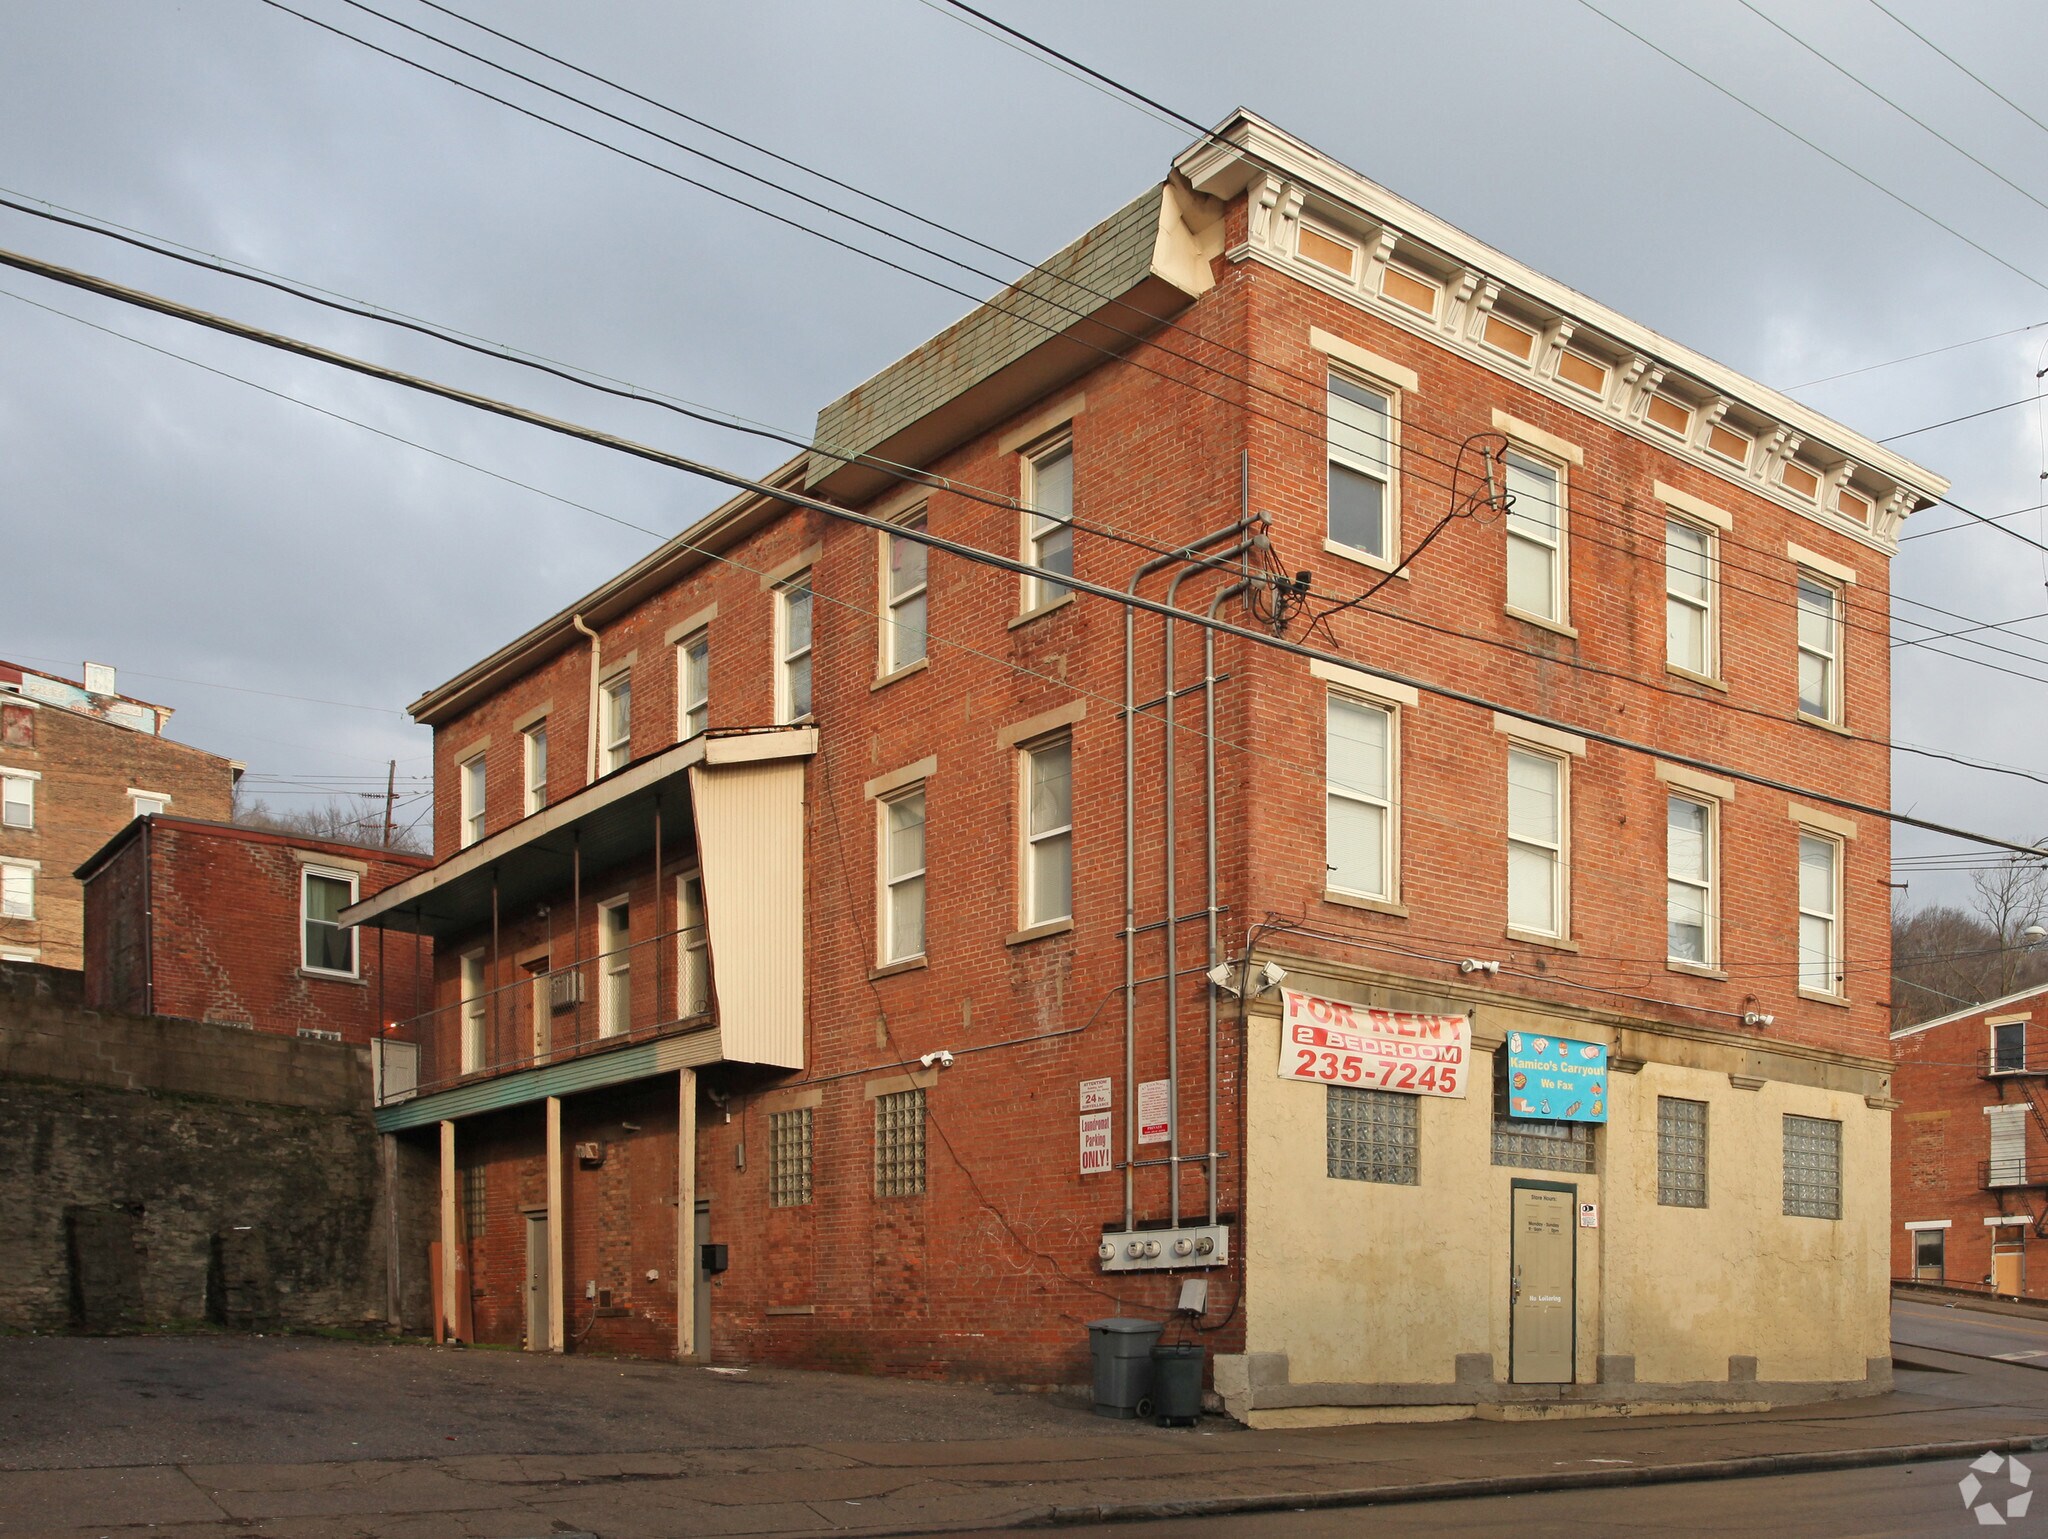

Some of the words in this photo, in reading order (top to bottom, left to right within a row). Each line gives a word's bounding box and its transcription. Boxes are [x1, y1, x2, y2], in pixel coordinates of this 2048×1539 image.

[1287, 992, 1357, 1029] FOR
[1369, 1009, 1465, 1040] RENT
[1297, 1028, 1314, 1043] 2
[1325, 1032, 1458, 1062] BEDROOM
[1294, 1049, 1457, 1093] 235-7245
[1510, 1057, 1558, 1072] Kamico's
[1560, 1062, 1605, 1077] Carryout
[1541, 1079, 1555, 1089] We
[1557, 1080, 1573, 1091] Fax
[1085, 1093, 1097, 1104] 24
[1082, 1116, 1109, 1132] Laundromat
[1085, 1133, 1106, 1147] Parking
[1082, 1149, 1109, 1169] ONLY!
[1538, 1295, 1562, 1303] Loitering
